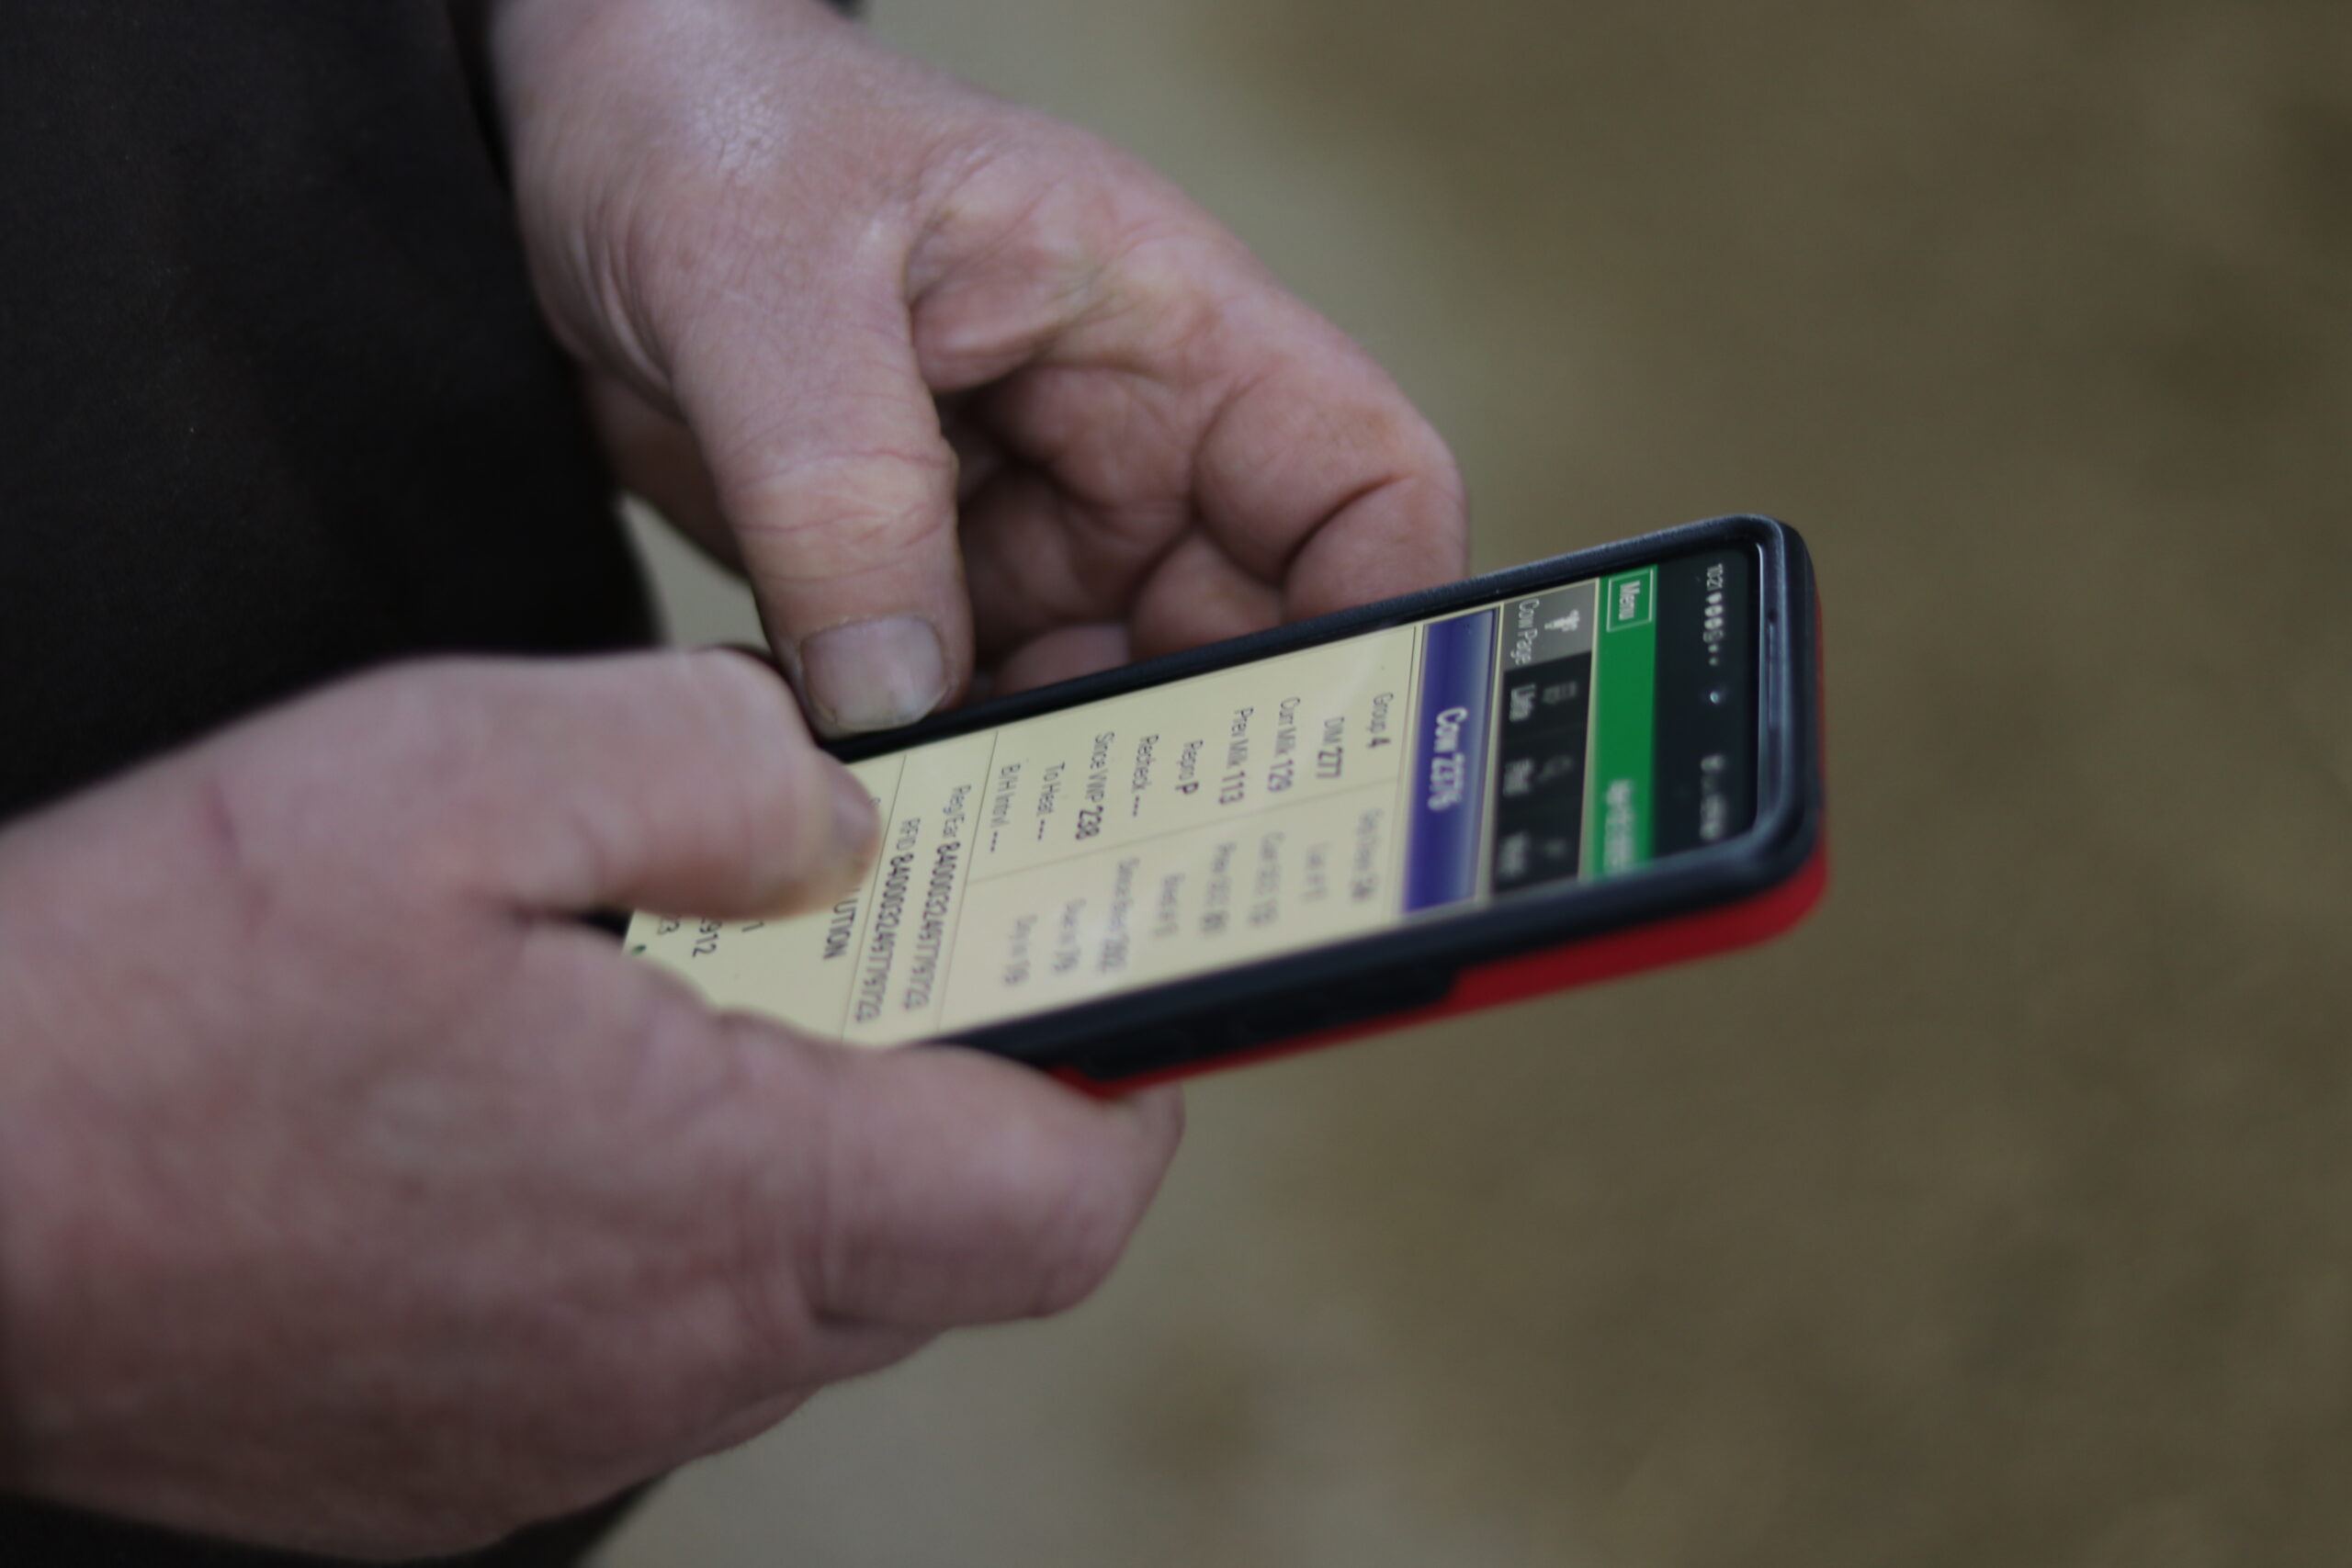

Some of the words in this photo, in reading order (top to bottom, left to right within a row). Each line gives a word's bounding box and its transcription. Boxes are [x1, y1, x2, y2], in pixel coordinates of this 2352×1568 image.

[1517, 597, 1539, 631] Cow
[1617, 580, 1639, 621] Menu
[1510, 627, 1537, 668] Page
[1229, 706, 1253, 739] Prev
[1277, 695, 1301, 728] Curr
[1366, 692, 1393, 735] Group
[1272, 726, 1296, 757] Milk
[1367, 733, 1390, 749] 4
[1432, 705, 1467, 755] Cow
[1089, 730, 1114, 769] Since
[1131, 733, 1159, 793] Recheck
[1173, 739, 1204, 782] Repro
[1226, 737, 1249, 769] Milk
[1314, 744, 1343, 783] 277
[997, 762, 1020, 793] B/H
[1043, 761, 1065, 783] To
[1083, 769, 1107, 805] VWP
[1173, 781, 1198, 797] P
[1217, 770, 1247, 806] 113
[1266, 757, 1295, 795] 129
[936, 783, 971, 841] Reg/Ear
[1036, 781, 1059, 817] Heat
[894, 817, 921, 851] RFID
[1073, 804, 1103, 841] 238
